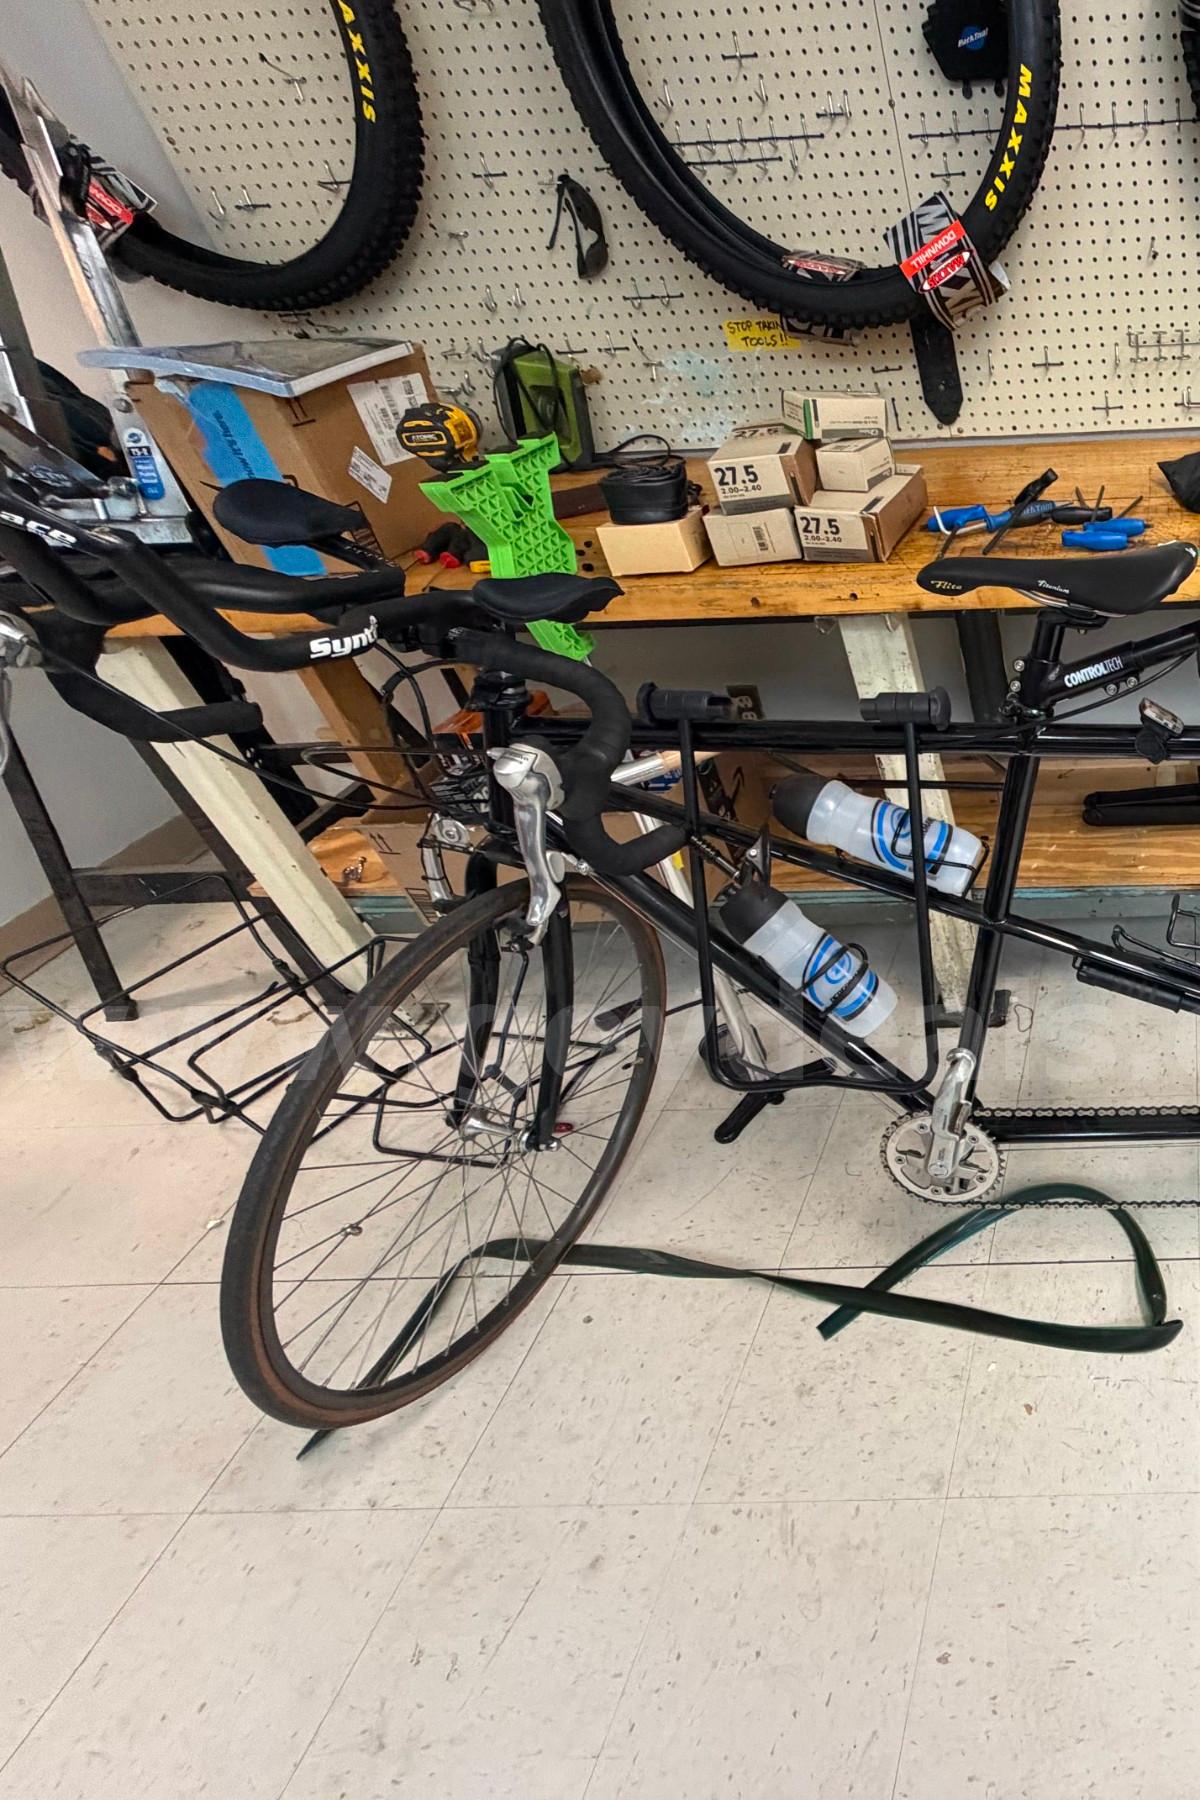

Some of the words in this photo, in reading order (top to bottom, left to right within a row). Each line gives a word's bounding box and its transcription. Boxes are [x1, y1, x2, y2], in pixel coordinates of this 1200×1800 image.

[336, 0, 376, 123] AXXIS
[985, 63, 1033, 211] MAXXIS
[909, 229, 958, 271] DOWNHILL
[726, 320, 753, 335] STOP
[713, 464, 759, 487] 27.5
[799, 515, 841, 535] 27.5
